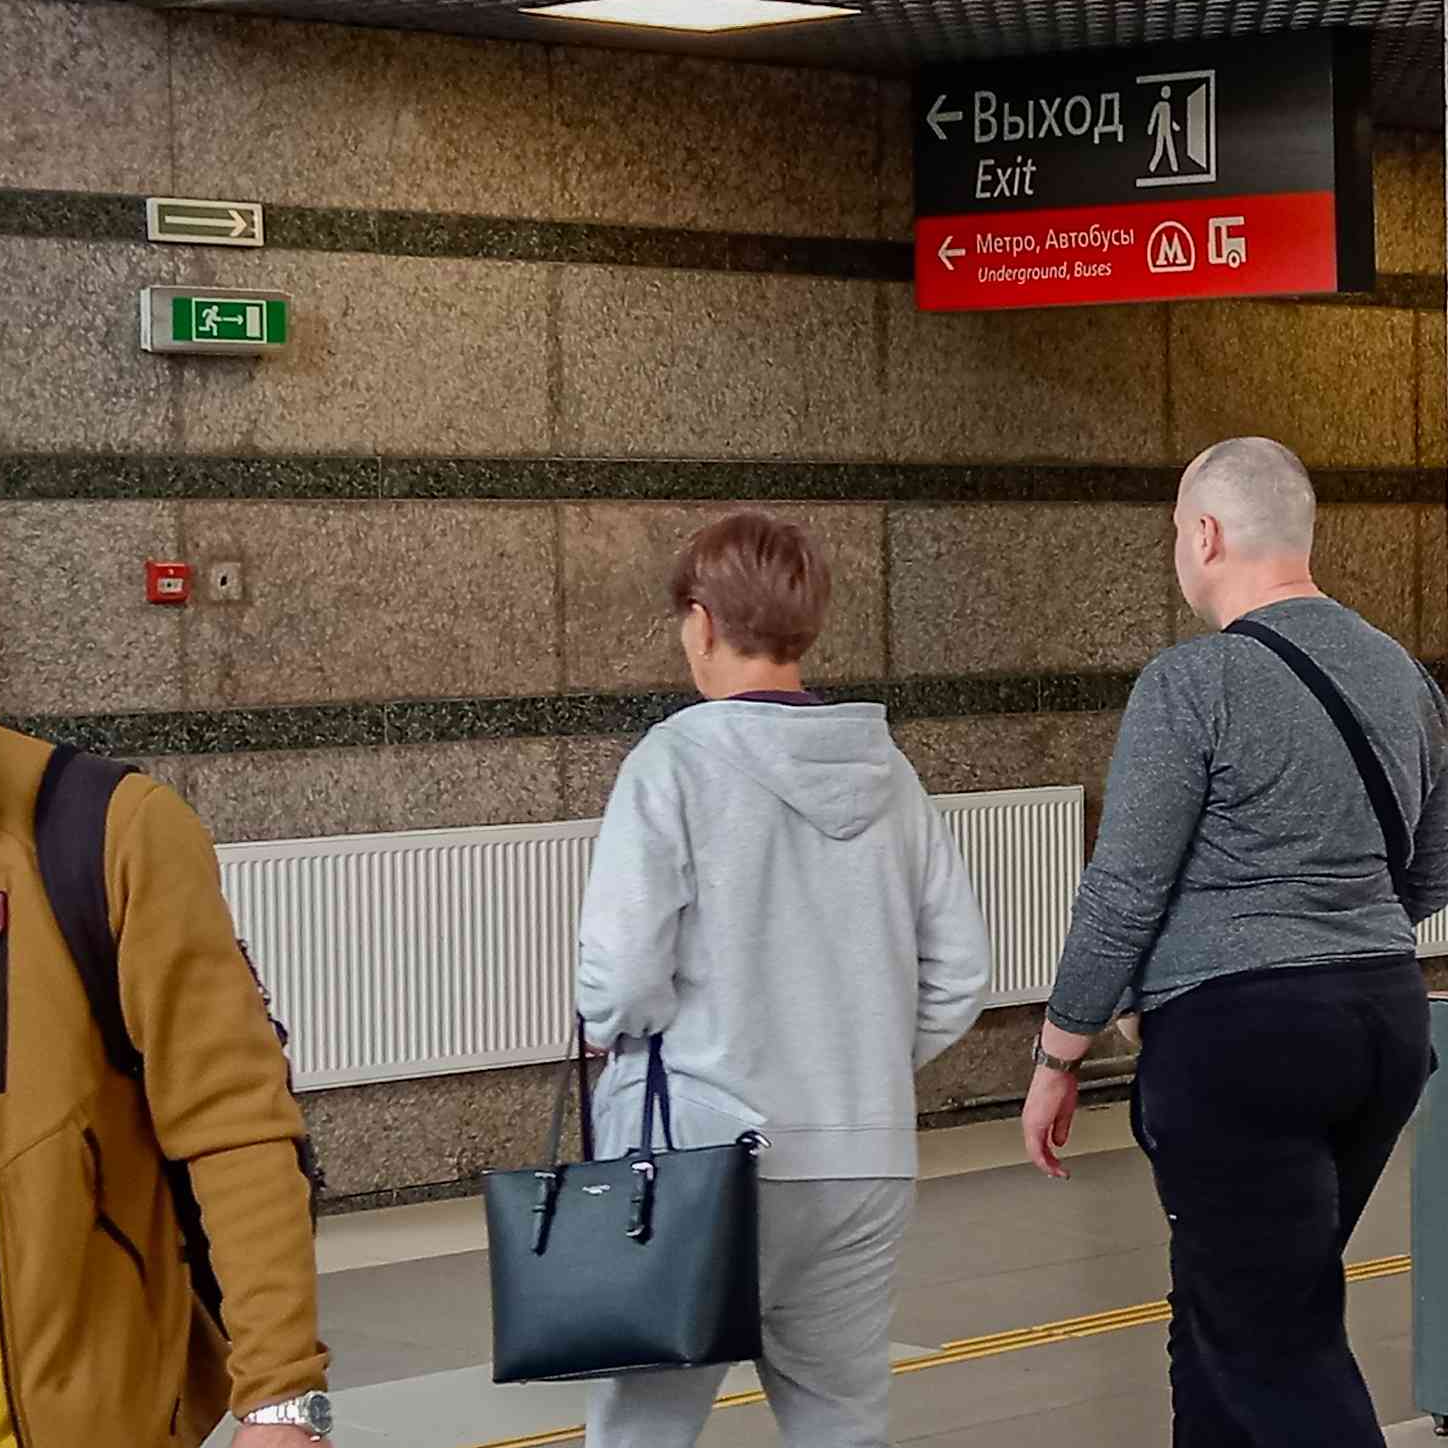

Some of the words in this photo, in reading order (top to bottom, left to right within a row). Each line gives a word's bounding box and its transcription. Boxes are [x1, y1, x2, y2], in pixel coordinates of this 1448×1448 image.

[973, 90, 1124, 144] Выход
[975, 155, 1037, 199] Exit
[976, 231, 1041, 258] Метро,
[1045, 223, 1135, 253] Автобусы
[978, 262, 1070, 286] Underground,
[1073, 261, 1112, 279] Buses
